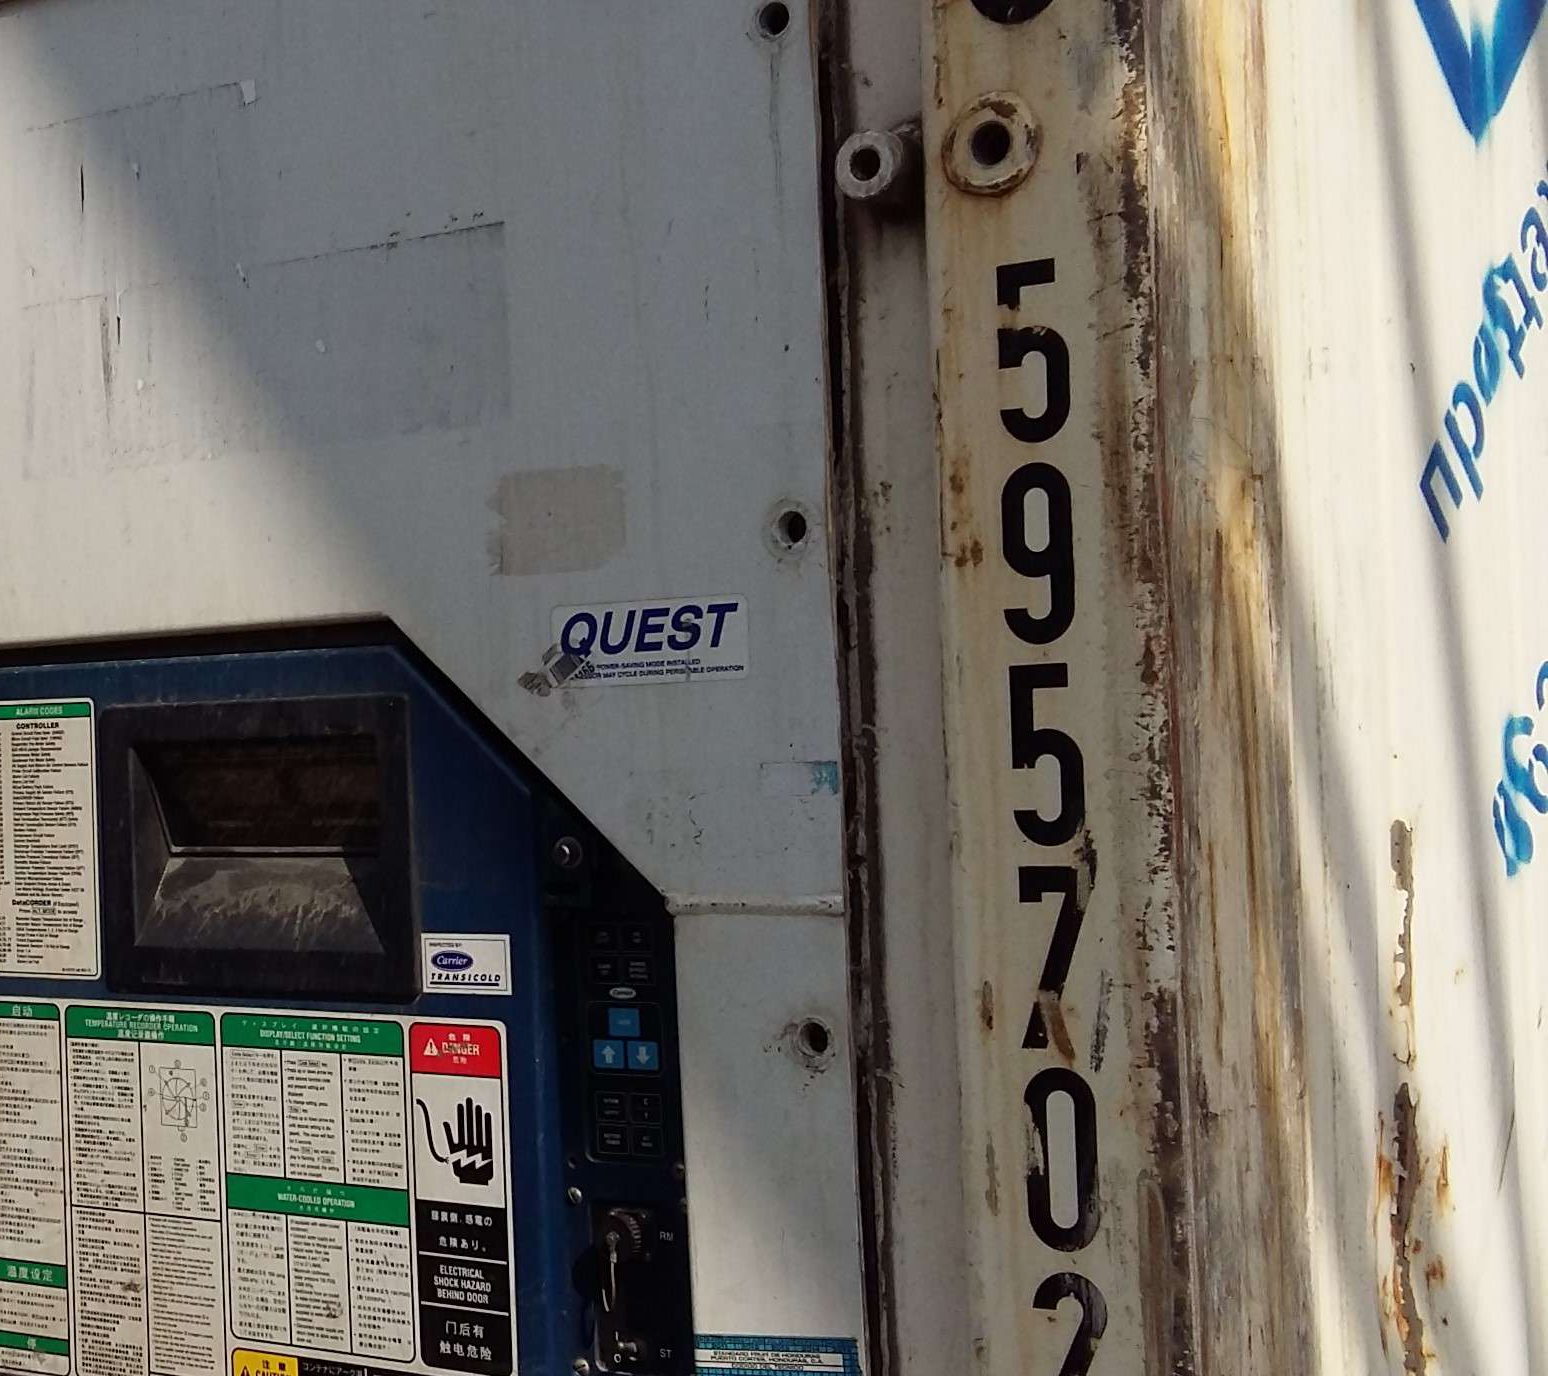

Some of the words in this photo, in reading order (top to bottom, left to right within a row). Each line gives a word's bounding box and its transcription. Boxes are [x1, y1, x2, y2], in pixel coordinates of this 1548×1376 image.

[1419, 160, 1548, 544] прода
[560, 602, 739, 657] QUEST
[38, 706, 63, 715] CODES
[16, 722, 60, 730] CONTROLLER
[436, 955, 468, 966] Carrier
[430, 973, 501, 982] TRANSICOLD
[84, 1019, 126, 1029] TEMPERATURE
[163, 1024, 199, 1033] OPERATION
[441, 1042, 480, 1056] DANGER
[277, 1192, 322, 1206] WATER-COOLED
[322, 1197, 356, 1209] OPERATION
[439, 1264, 485, 1280] ELECTRICAL
[433, 1276, 460, 1289] SHOCK
[460, 1278, 492, 1293] HAZARD
[437, 1288, 465, 1301] BEHIND
[466, 1291, 490, 1305] DOOR
[445, 1320, 485, 1339] 门后有
[439, 1340, 492, 1361] 触电危险
